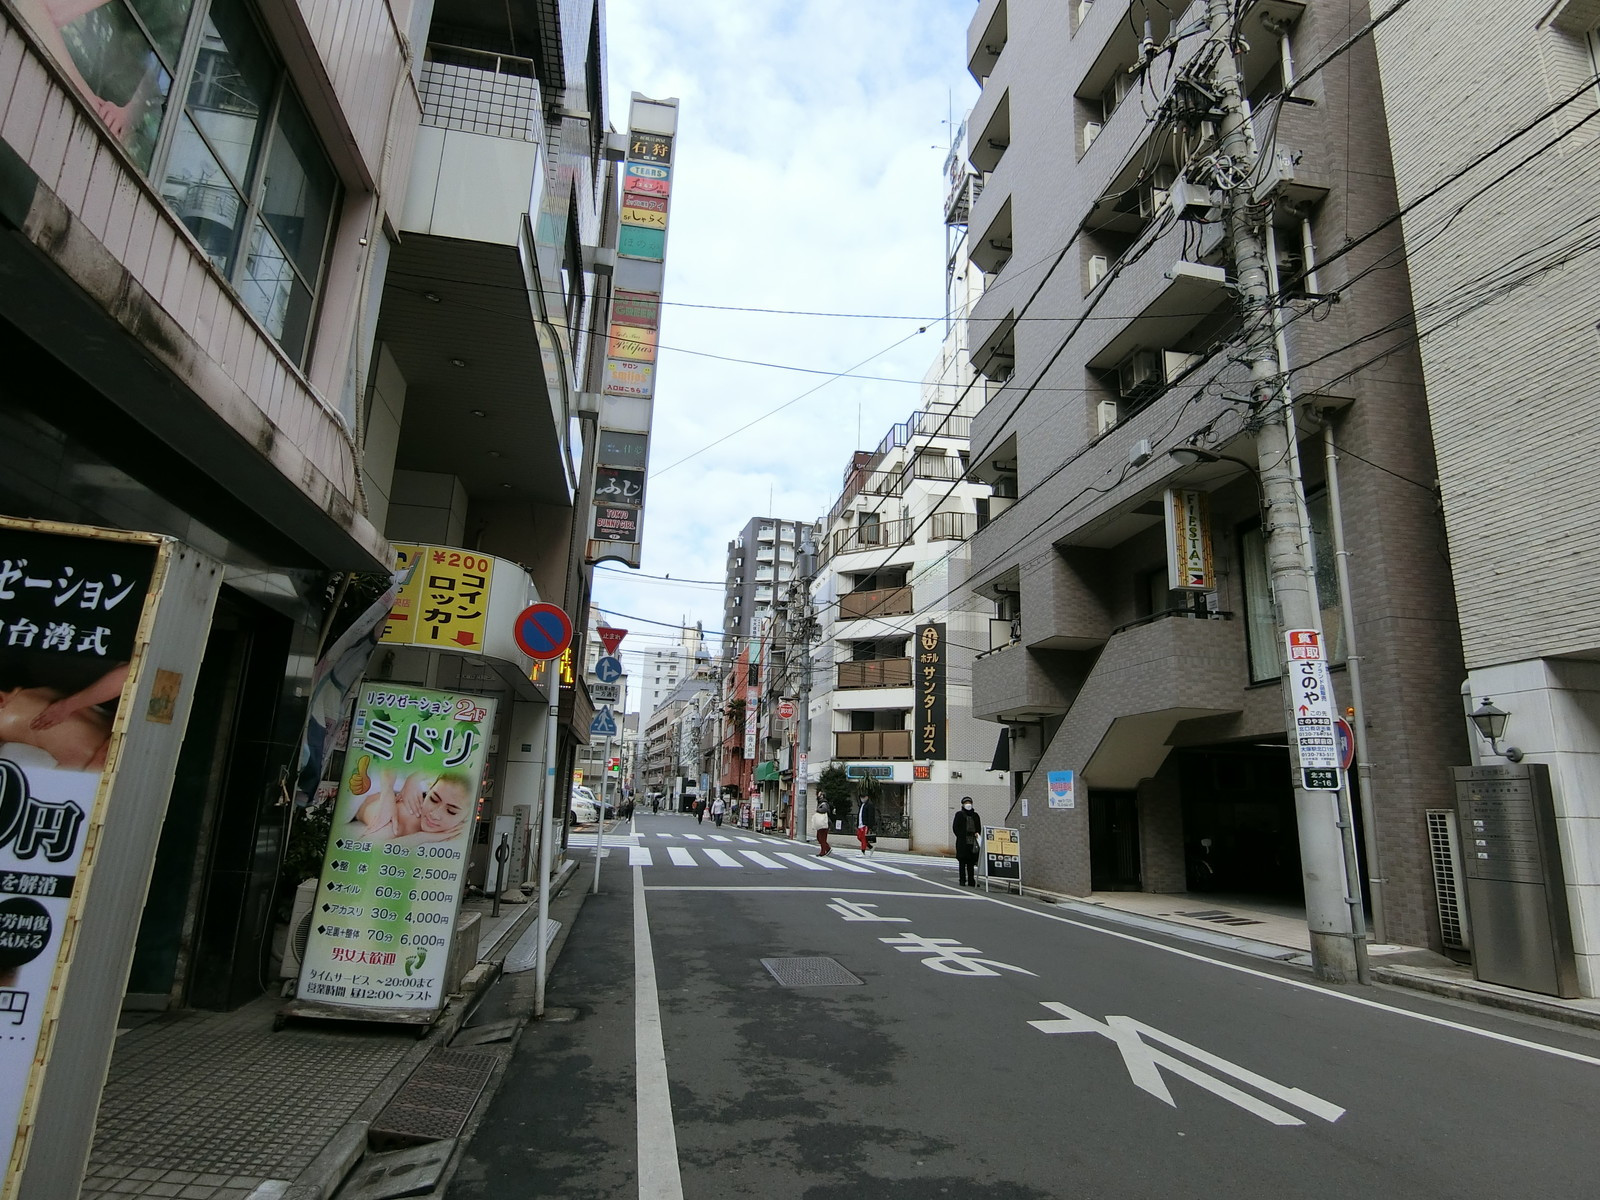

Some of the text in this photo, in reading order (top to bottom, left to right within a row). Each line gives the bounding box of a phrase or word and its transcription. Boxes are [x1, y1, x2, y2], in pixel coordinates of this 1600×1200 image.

[632, 141, 669, 157] 石狩
[635, 167, 662, 177] TEARS
[632, 210, 665, 225] しゃらく
[607, 384, 641, 393] 入口はこちら
[596, 477, 641, 497] ふじ
[606, 509, 629, 519] TOKYO
[620, 520, 636, 531] GIRL
[1187, 494, 1200, 561] FIESTA
[432, 550, 489, 573] ¥200
[0, 558, 137, 611] ゼーション
[456, 573, 486, 620] コイン
[424, 575, 457, 640] ロッカー
[0, 617, 112, 656] 台湾式
[602, 632, 621, 641] 止まれ
[920, 653, 939, 664] ホテル
[1292, 647, 1319, 659] 買取
[1300, 661, 1320, 705] さのや
[367, 691, 487, 723] リラクゼーション 2F
[923, 666, 936, 753] サンターガス
[363, 719, 474, 767] ミドリ
[1310, 771, 1332, 779] 北大塚
[1312, 779, 1332, 787] 2-16
[343, 839, 461, 860] 足つぼ 30分 3,000円
[379, 864, 406, 877] 30分
[412, 867, 458, 882] 2,500円
[1, 874, 58, 896] を解消
[335, 883, 453, 903] オイル 60分 6,000円
[0, 913, 50, 931] 労回復
[330, 904, 449, 925] アカスリ 30分 4,000円
[367, 929, 394, 943] 70分
[400, 934, 445, 947] 6,000円
[331, 947, 397, 966] 男女大歓迎
[309, 968, 370, 986] タイムサービス
[306, 982, 346, 998] 営業時間
[826, 897, 1347, 1126] 止まれ
